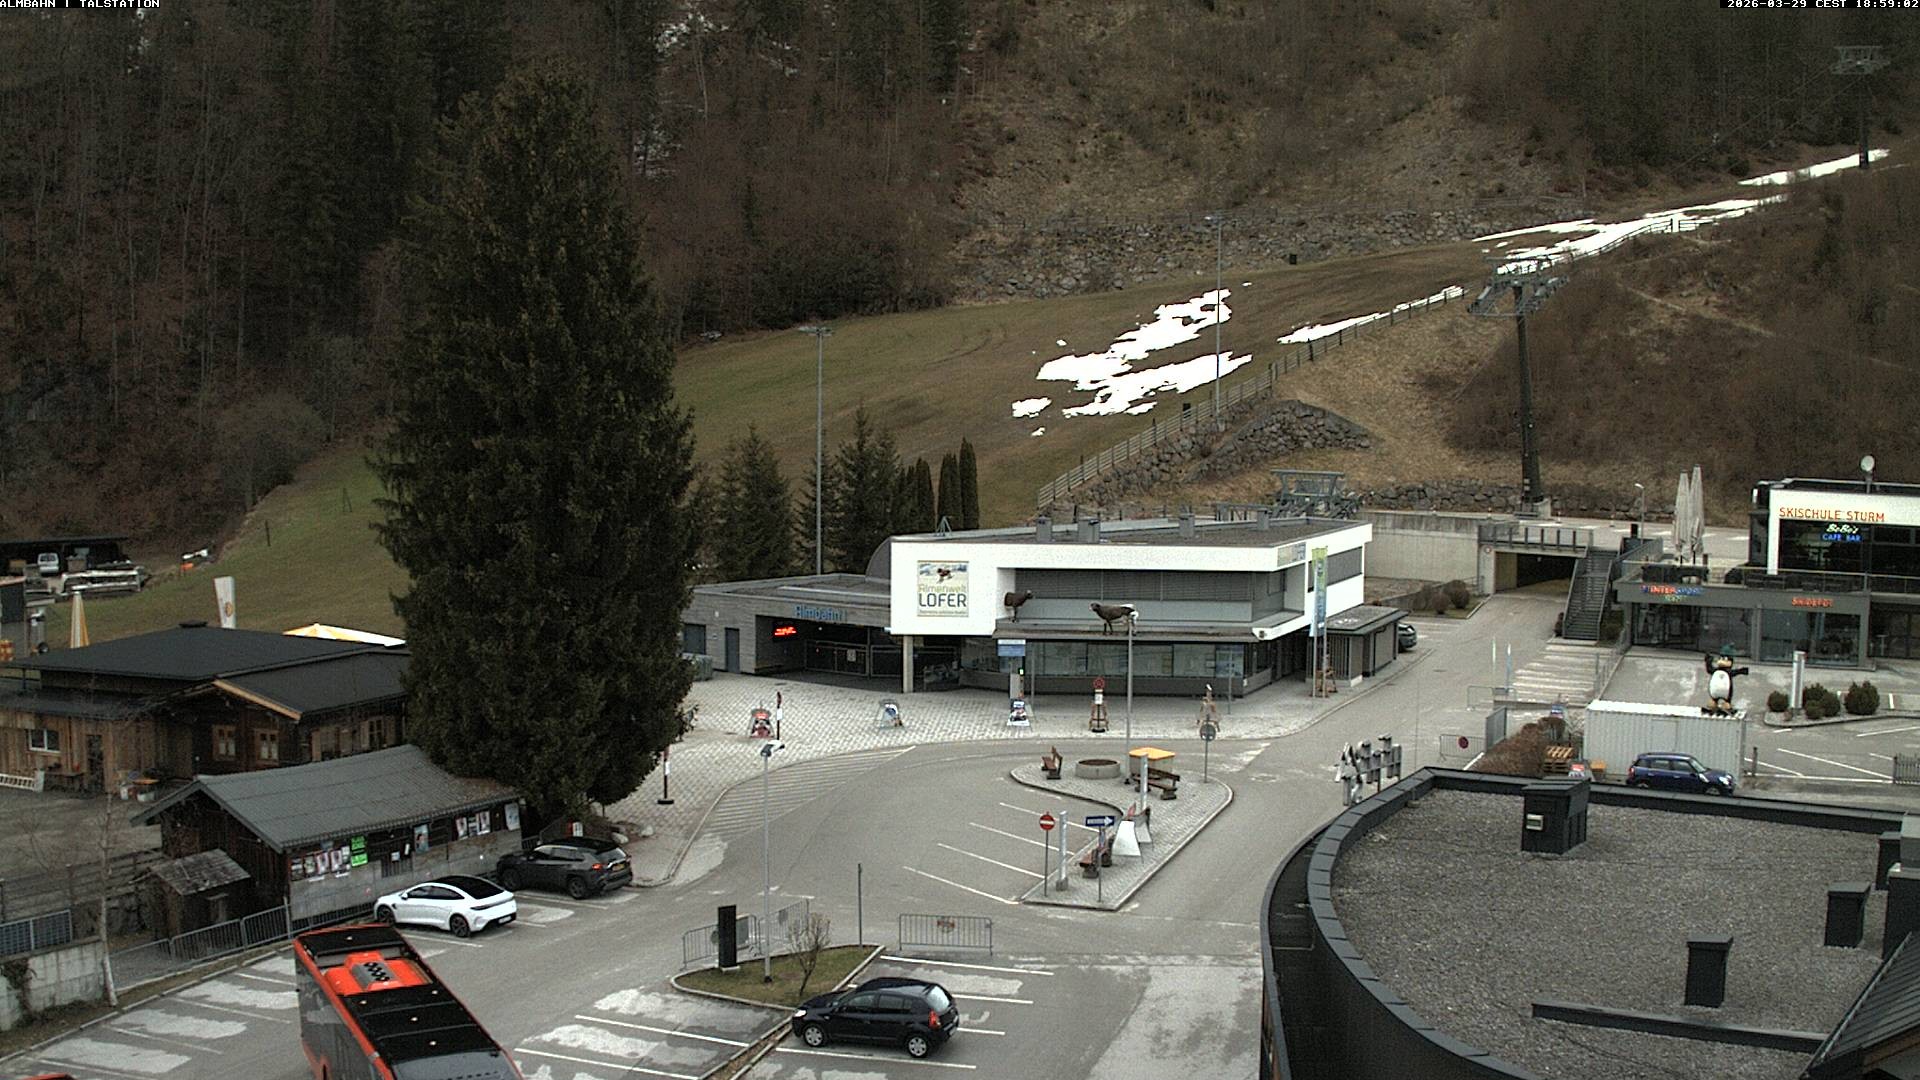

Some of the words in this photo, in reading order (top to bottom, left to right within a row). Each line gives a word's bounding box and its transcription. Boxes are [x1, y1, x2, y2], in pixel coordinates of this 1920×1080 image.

[1779, 507, 1841, 520] SKISCHULE
[1846, 511, 1885, 522] STURM
[918, 593, 967, 607] LOFER
